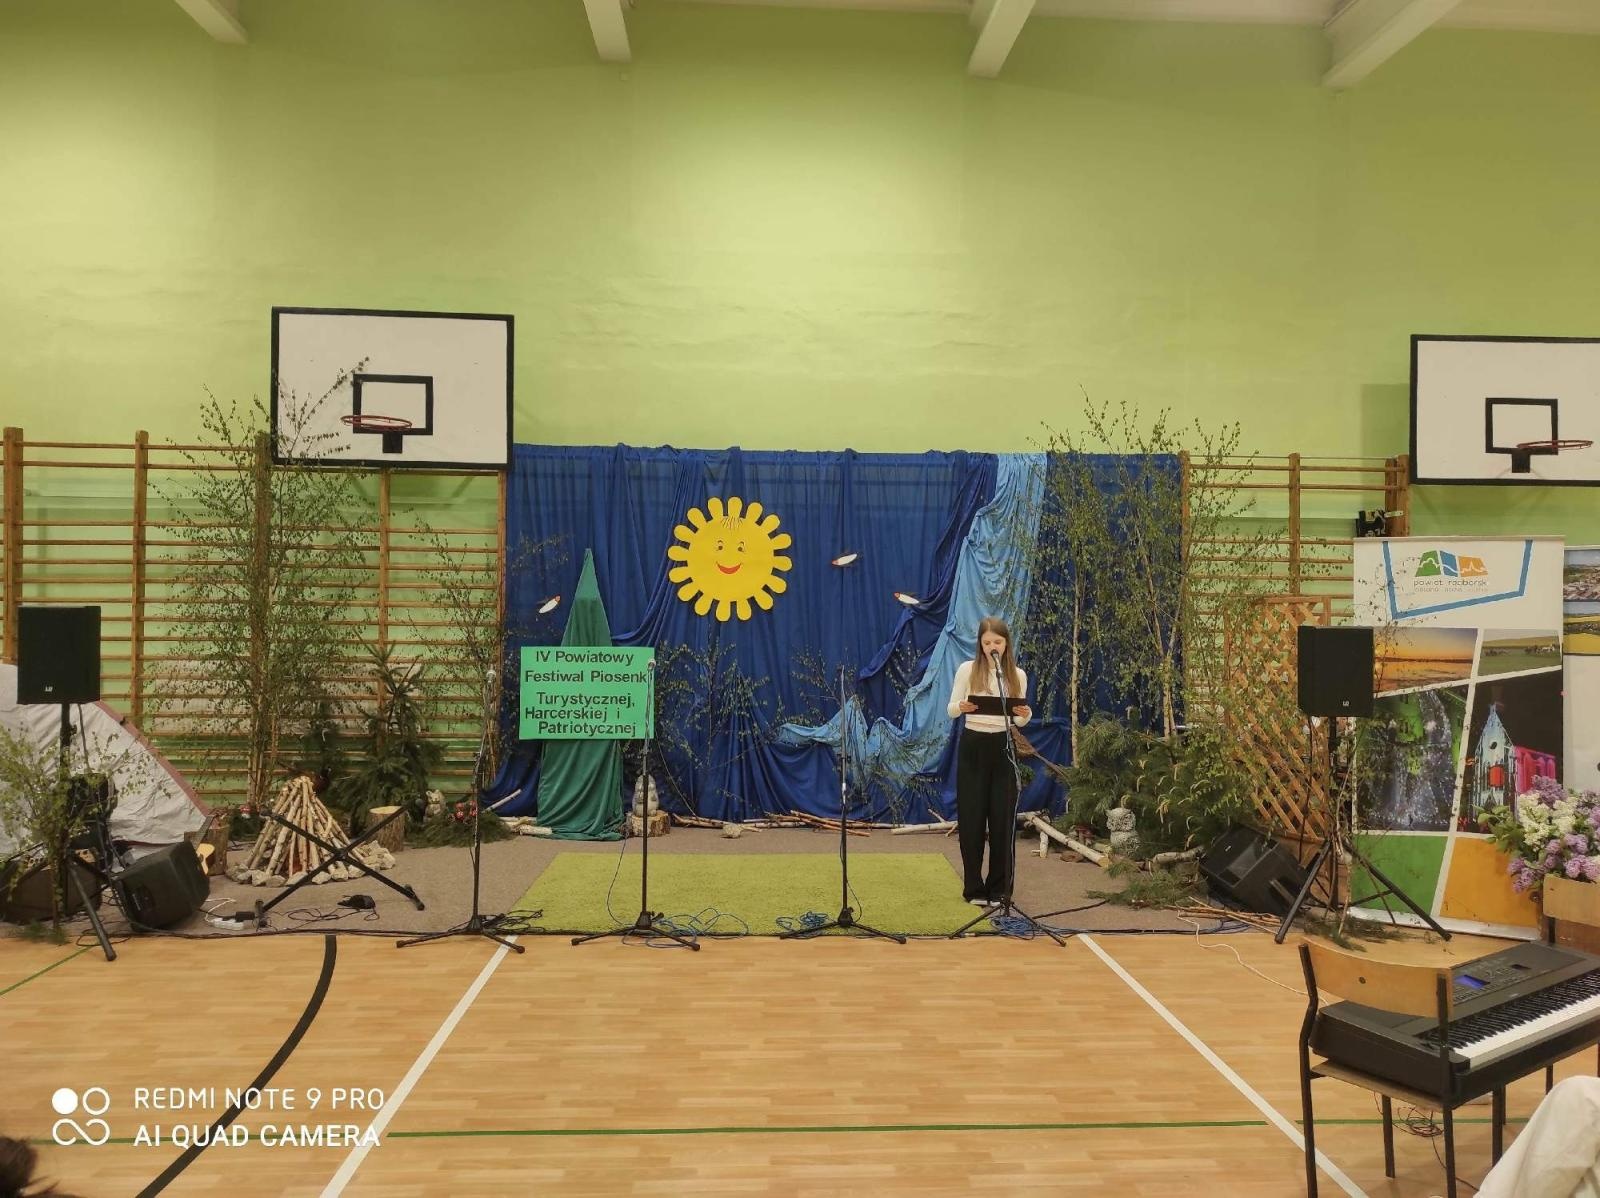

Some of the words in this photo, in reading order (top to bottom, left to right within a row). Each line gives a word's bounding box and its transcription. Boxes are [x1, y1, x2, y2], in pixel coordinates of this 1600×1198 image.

[535, 650, 551, 663] IV
[555, 650, 634, 667] Powiatowy
[525, 670, 584, 683] Festiwal
[537, 692, 635, 708] Turystycznej,
[525, 707, 607, 723] Harcerskiej
[616, 707, 620, 719] i
[538, 720, 637, 737] Patriotycznej
